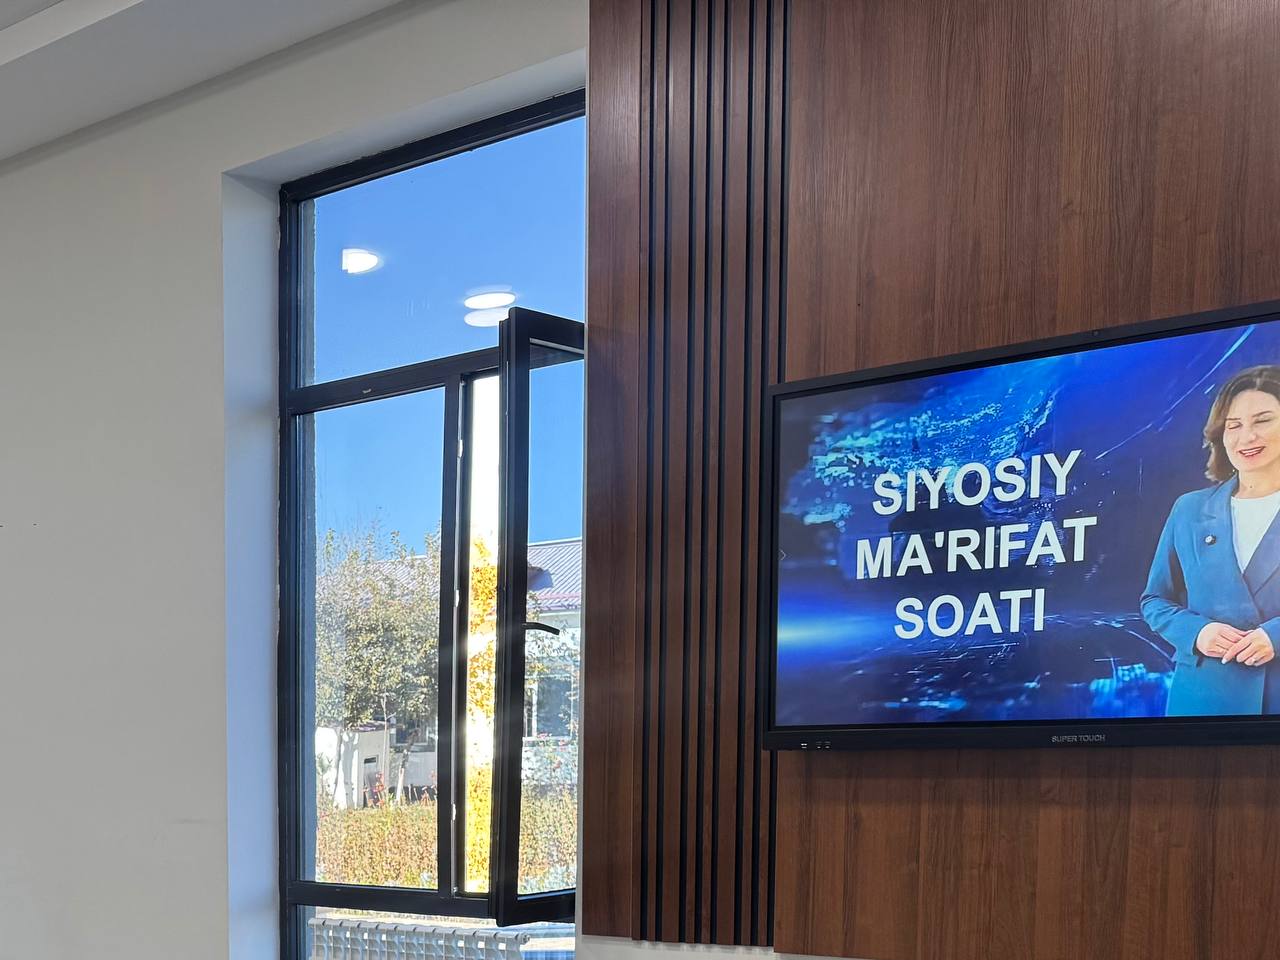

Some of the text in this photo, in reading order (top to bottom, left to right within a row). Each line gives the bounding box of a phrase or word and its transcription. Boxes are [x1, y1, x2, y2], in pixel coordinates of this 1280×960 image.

[872, 449, 1083, 516] SIYOSIY
[856, 516, 1098, 580] MA'RIFAT
[894, 588, 1046, 640] SOATI
[1078, 734, 1106, 742] TOUCH
